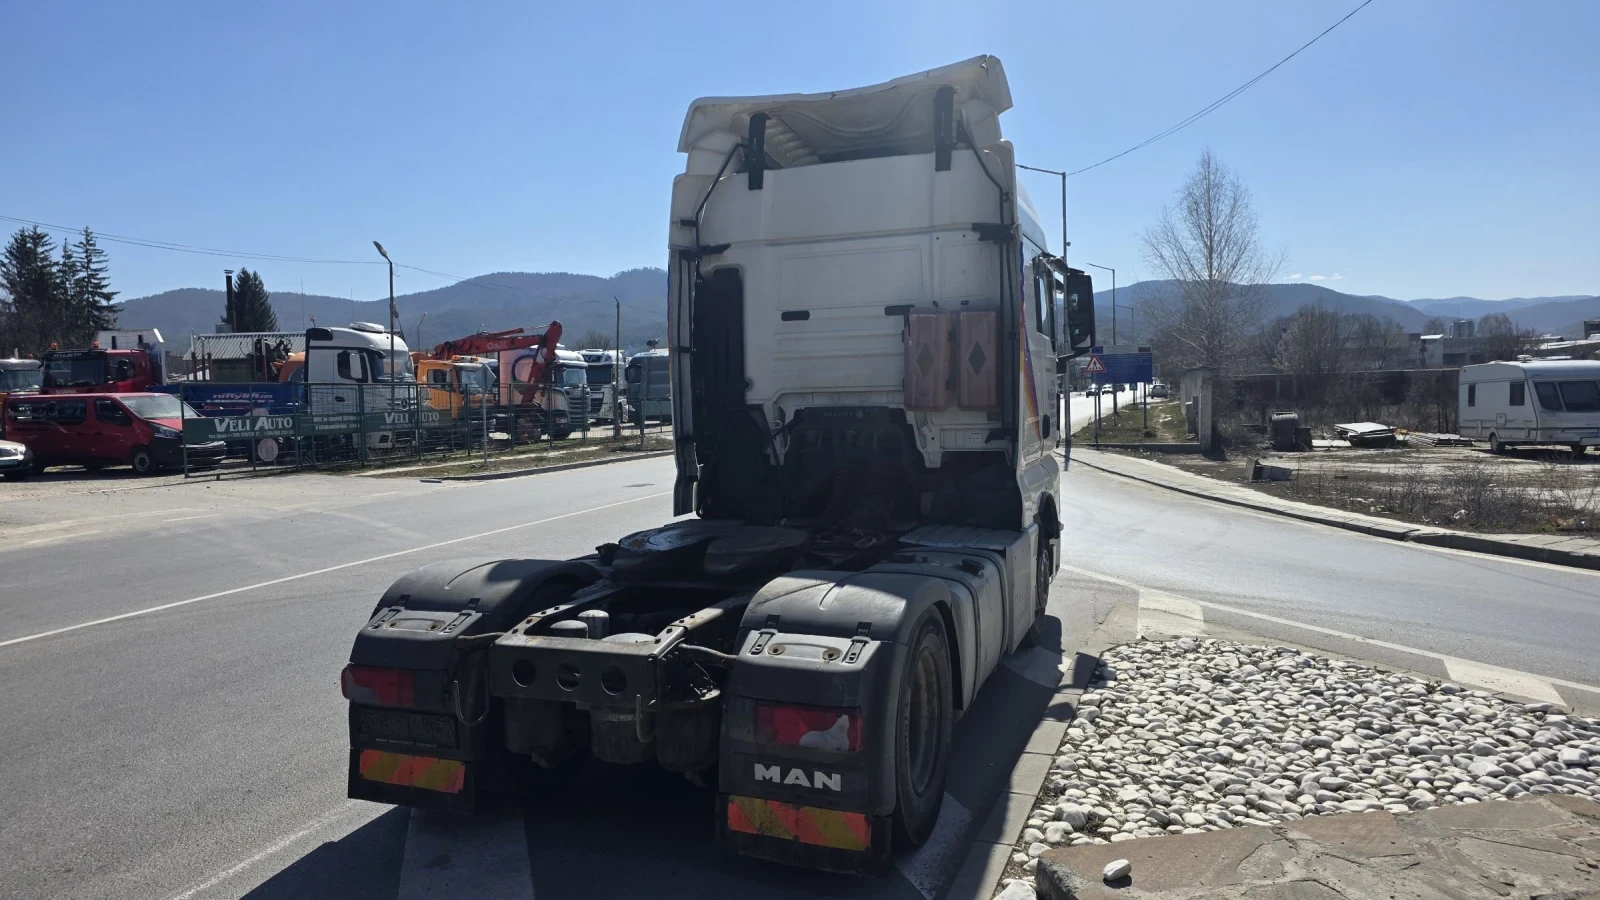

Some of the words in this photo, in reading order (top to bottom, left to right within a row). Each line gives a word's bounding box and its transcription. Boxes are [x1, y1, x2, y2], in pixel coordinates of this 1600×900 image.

[214, 418, 251, 432] VELI
[254, 417, 293, 430] AUTO
[384, 412, 409, 423] VELI
[754, 763, 841, 792] MAN
